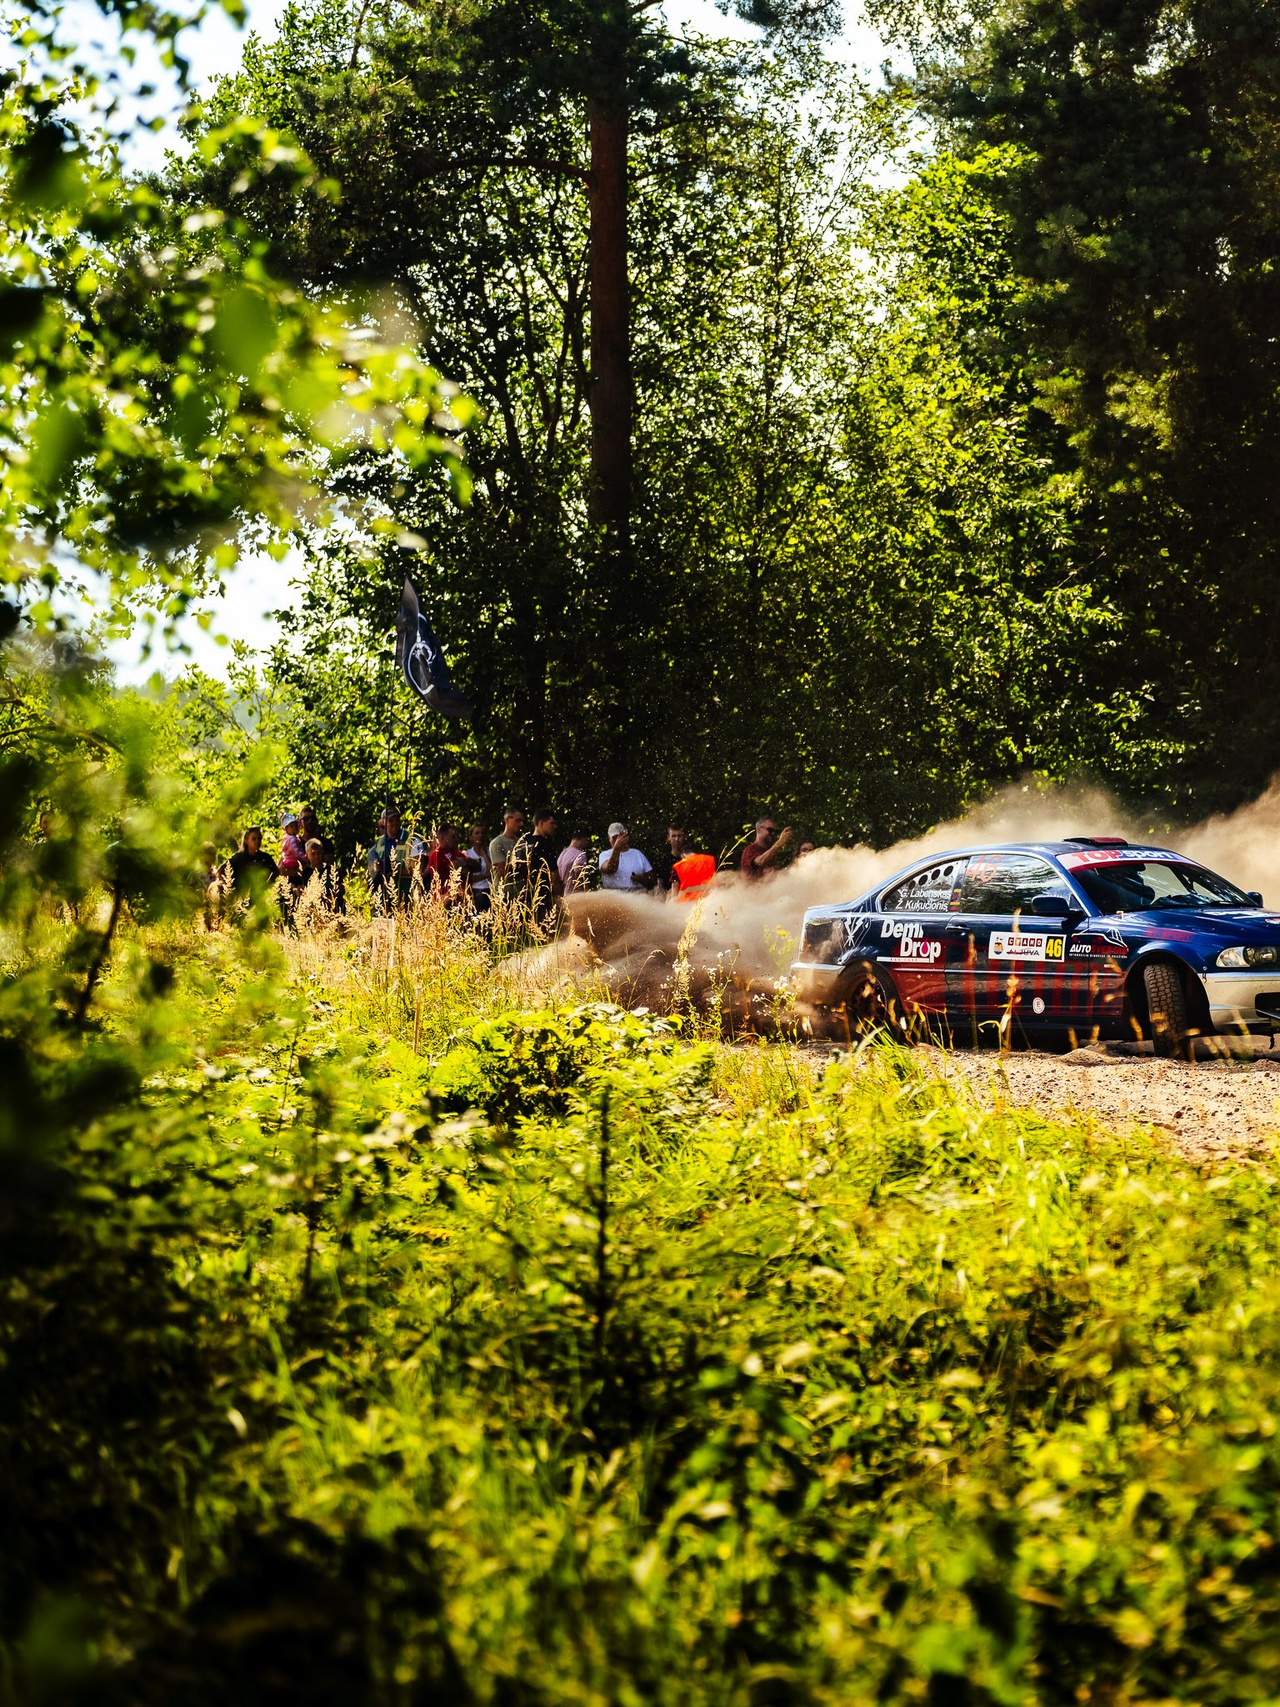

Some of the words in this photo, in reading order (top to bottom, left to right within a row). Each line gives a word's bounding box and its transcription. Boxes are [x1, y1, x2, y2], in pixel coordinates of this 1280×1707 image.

[966, 855, 1003, 883] 46
[900, 937, 941, 963] Drop
[1045, 938, 1063, 958] 46
